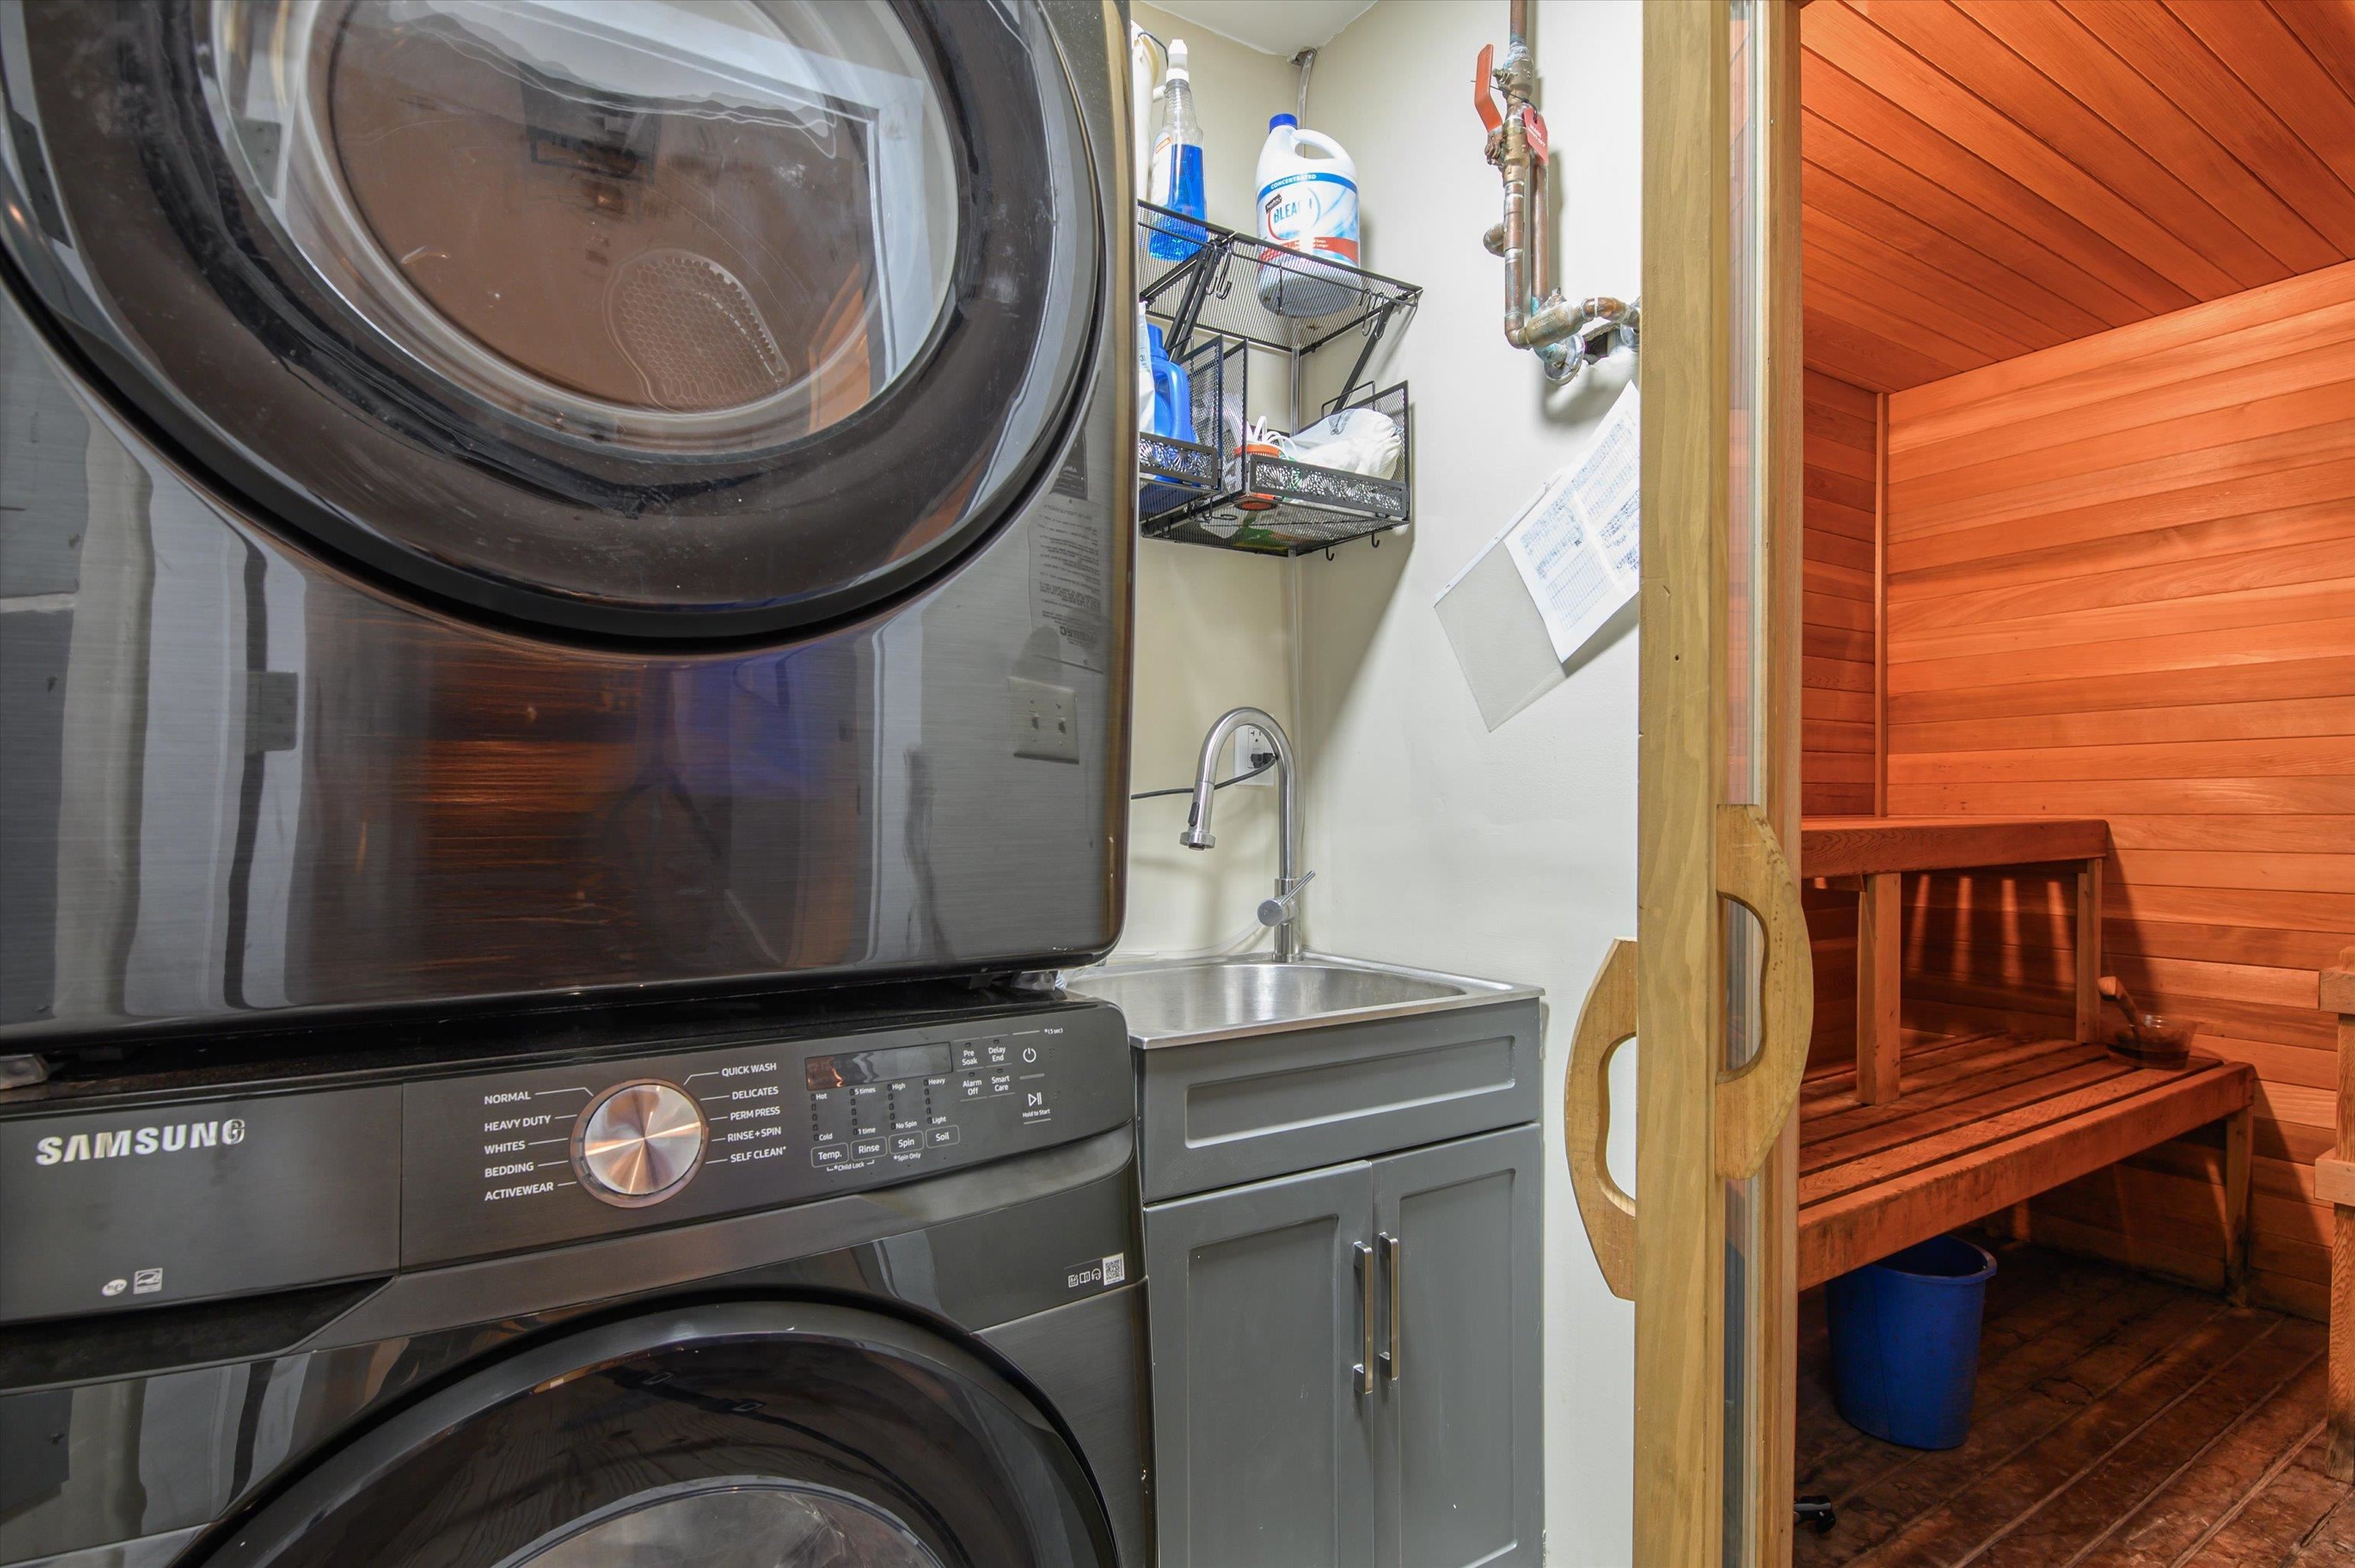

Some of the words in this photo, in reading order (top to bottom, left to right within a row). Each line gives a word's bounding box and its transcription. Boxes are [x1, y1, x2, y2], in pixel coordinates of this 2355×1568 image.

[988, 1046, 1006, 1055] Delay
[961, 1057, 978, 1066] Soak
[992, 1054, 1004, 1062] End
[721, 1065, 750, 1078] QUICK
[751, 1062, 777, 1074] WASH
[928, 1078, 945, 1086] Heavy
[991, 1075, 1010, 1084] Smart
[732, 1086, 779, 1100] DELICATES
[967, 1087, 979, 1096] Off
[994, 1084, 1009, 1092] Care
[484, 1091, 531, 1104] NORMAL
[730, 1110, 754, 1120] PERM
[755, 1106, 780, 1117] PRESS
[484, 1119, 521, 1132] HEAVY
[523, 1115, 551, 1127] DUTY
[905, 1120, 918, 1129] Spin
[932, 1116, 946, 1124] Light
[819, 1133, 833, 1141] Cold
[935, 1131, 950, 1142] Soil
[35, 1119, 245, 1166] SAMSUNG
[484, 1140, 526, 1155] WHITES
[898, 1138, 915, 1149] Spin
[859, 1143, 880, 1154] Rinse
[731, 1151, 752, 1163] SELF
[818, 1150, 842, 1160] Temp.
[909, 1152, 921, 1160] Only
[484, 1162, 534, 1178] BEDDING
[484, 1182, 554, 1202] ACTIVEWEAR
